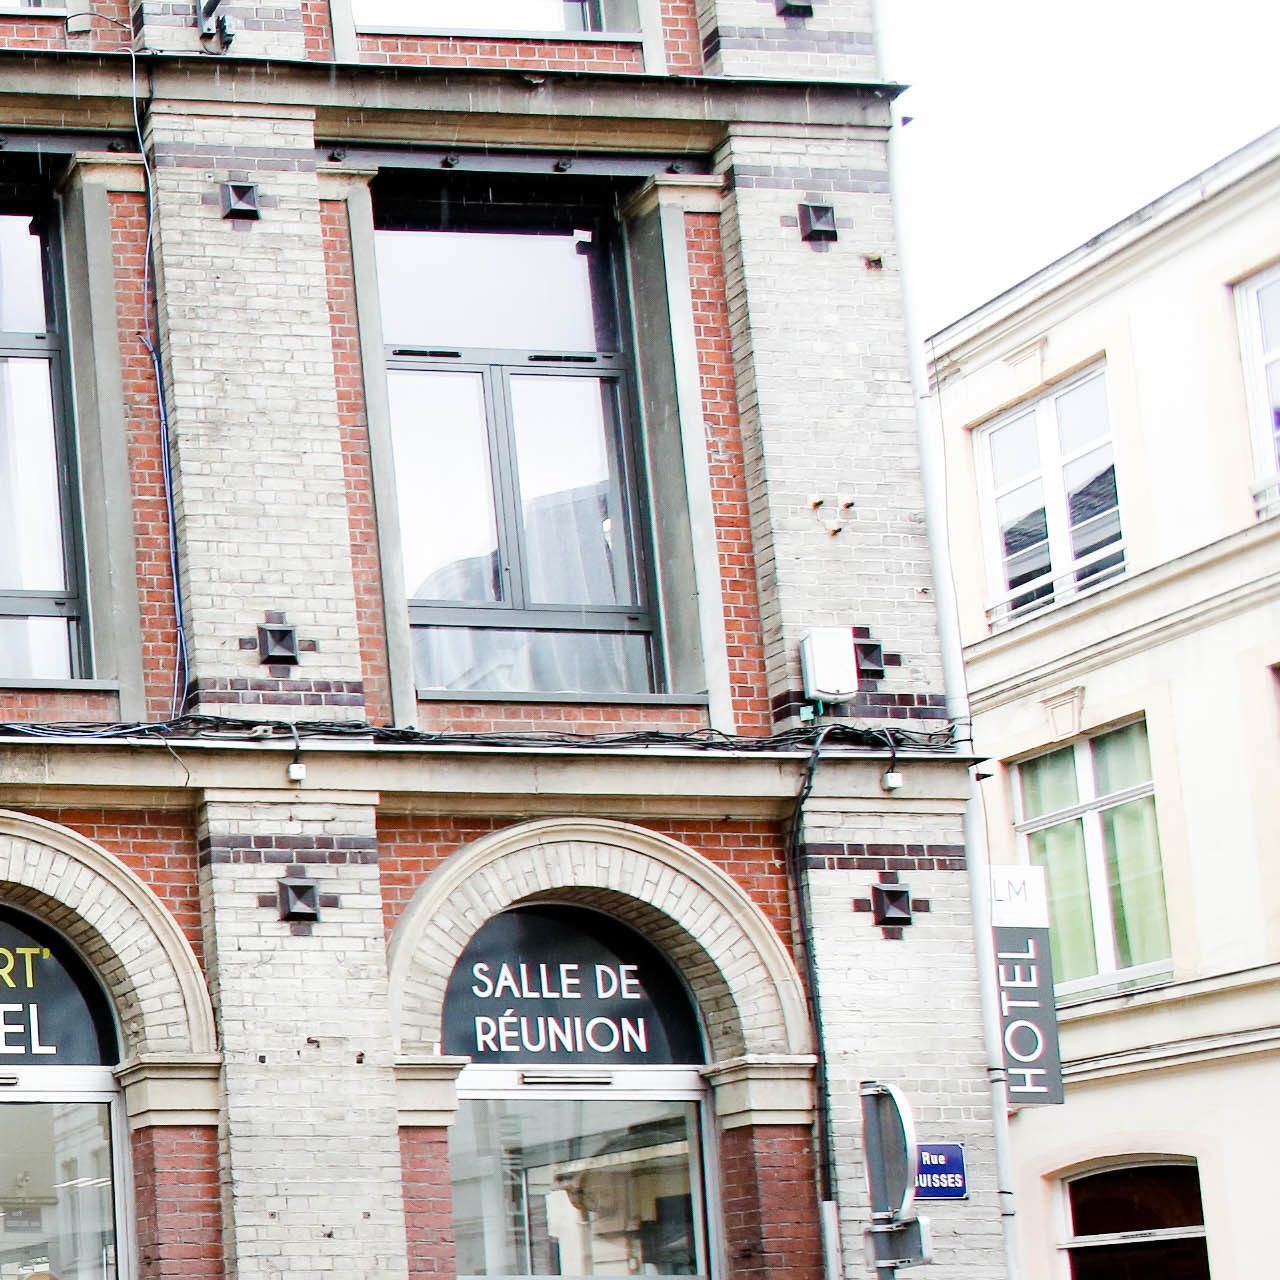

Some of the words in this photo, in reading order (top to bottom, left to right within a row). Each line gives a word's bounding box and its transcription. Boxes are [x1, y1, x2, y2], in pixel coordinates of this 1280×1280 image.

[471, 962, 582, 999] SALLE
[595, 964, 641, 999] DE
[474, 1008, 649, 1054] RÉUNION
[921, 1151, 947, 1166] Rue
